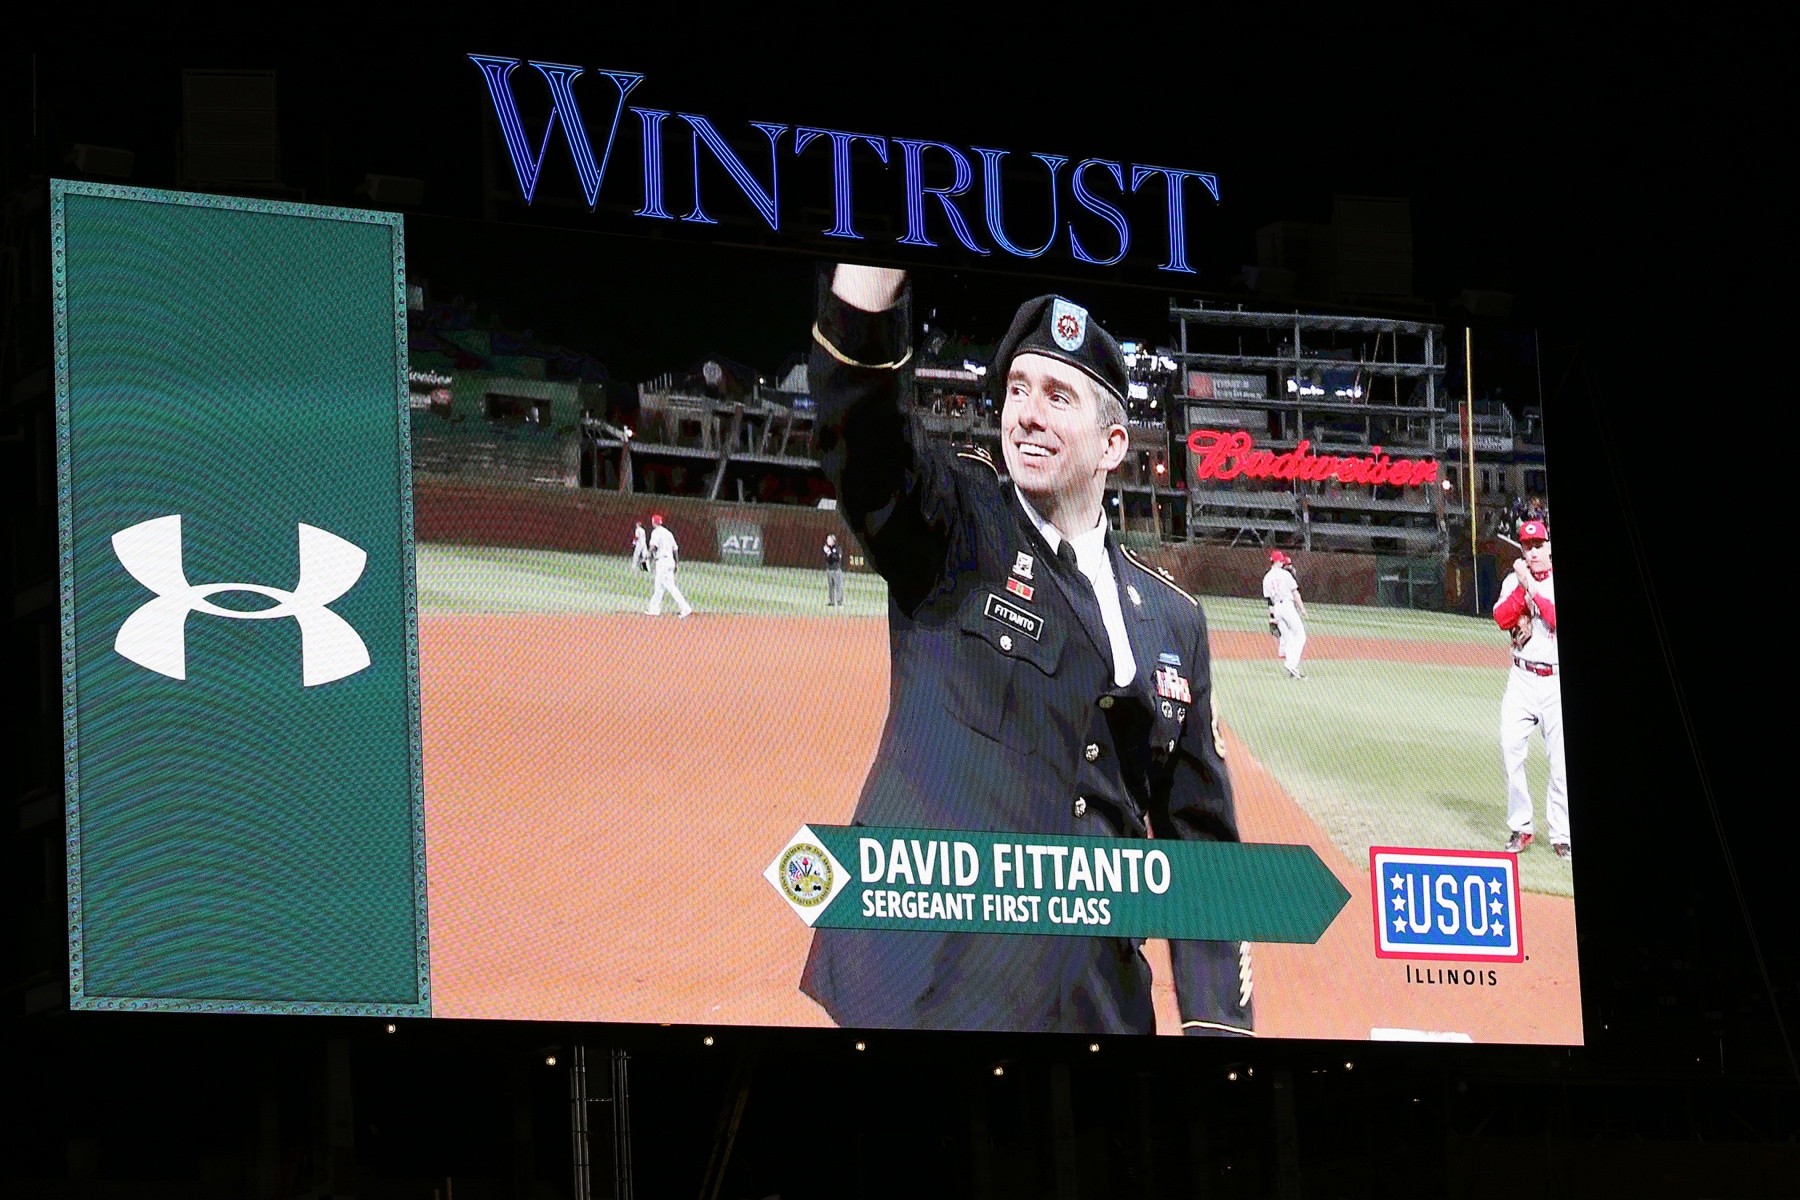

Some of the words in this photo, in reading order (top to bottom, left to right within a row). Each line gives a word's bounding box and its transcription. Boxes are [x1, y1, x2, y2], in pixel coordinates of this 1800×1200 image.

[466, 53, 1220, 274] WINTRUST
[1187, 429, 1439, 486] Budweiser
[994, 604, 1035, 632] FITTANTO
[859, 837, 980, 887] DAVID
[993, 843, 1172, 894] FITTANTO
[862, 889, 976, 921] SERGEANT
[983, 894, 1041, 923] FIRST
[1048, 896, 1112, 926] CLASS
[1406, 873, 1489, 937] USO
[1406, 964, 1497, 986] ILLINOIS
